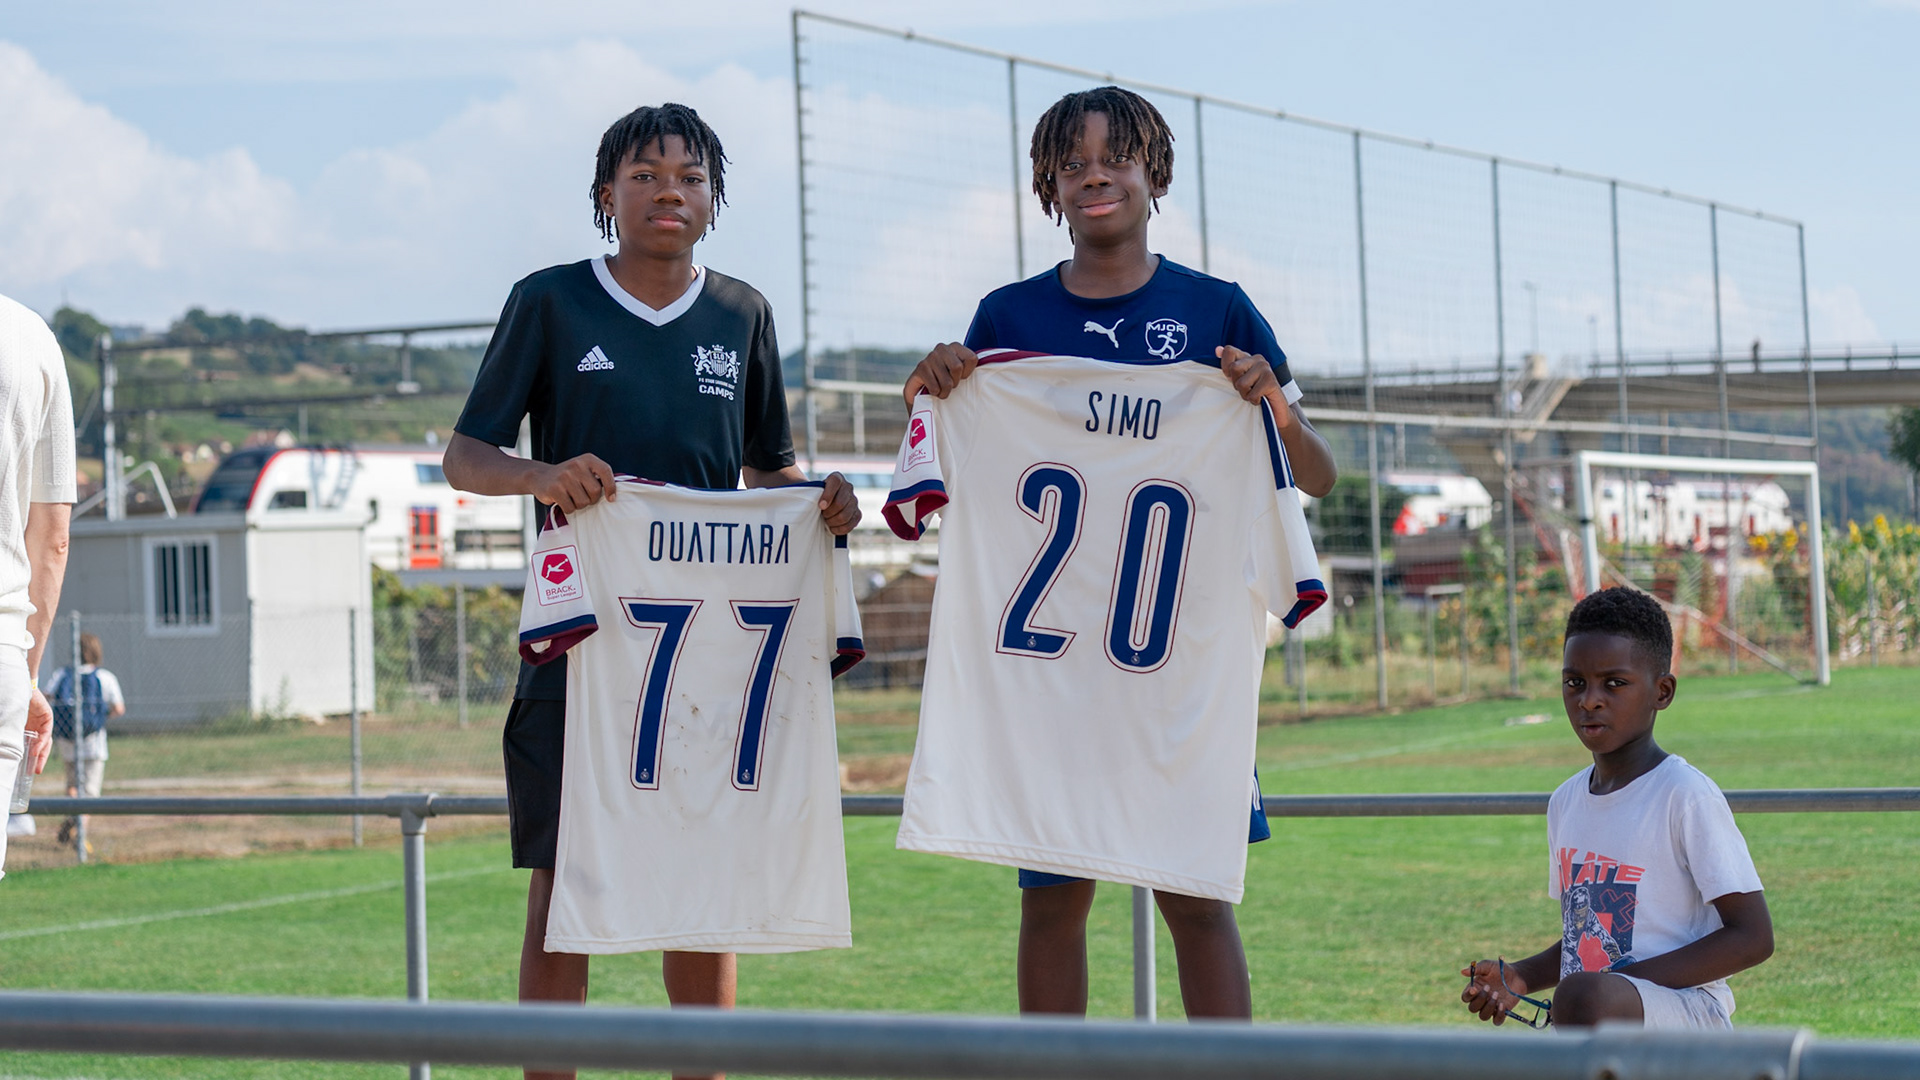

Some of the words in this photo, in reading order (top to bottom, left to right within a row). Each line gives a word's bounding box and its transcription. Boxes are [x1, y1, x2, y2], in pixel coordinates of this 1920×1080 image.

[1148, 323, 1186, 333] MJOR
[577, 361, 615, 371] adidas
[698, 384, 735, 400] CAMPS
[1085, 391, 1161, 440] SIMO
[648, 520, 789, 564] OUATTARA
[995, 462, 1196, 674] 20
[618, 596, 800, 791] 77
[1557, 847, 1646, 892] KATE
